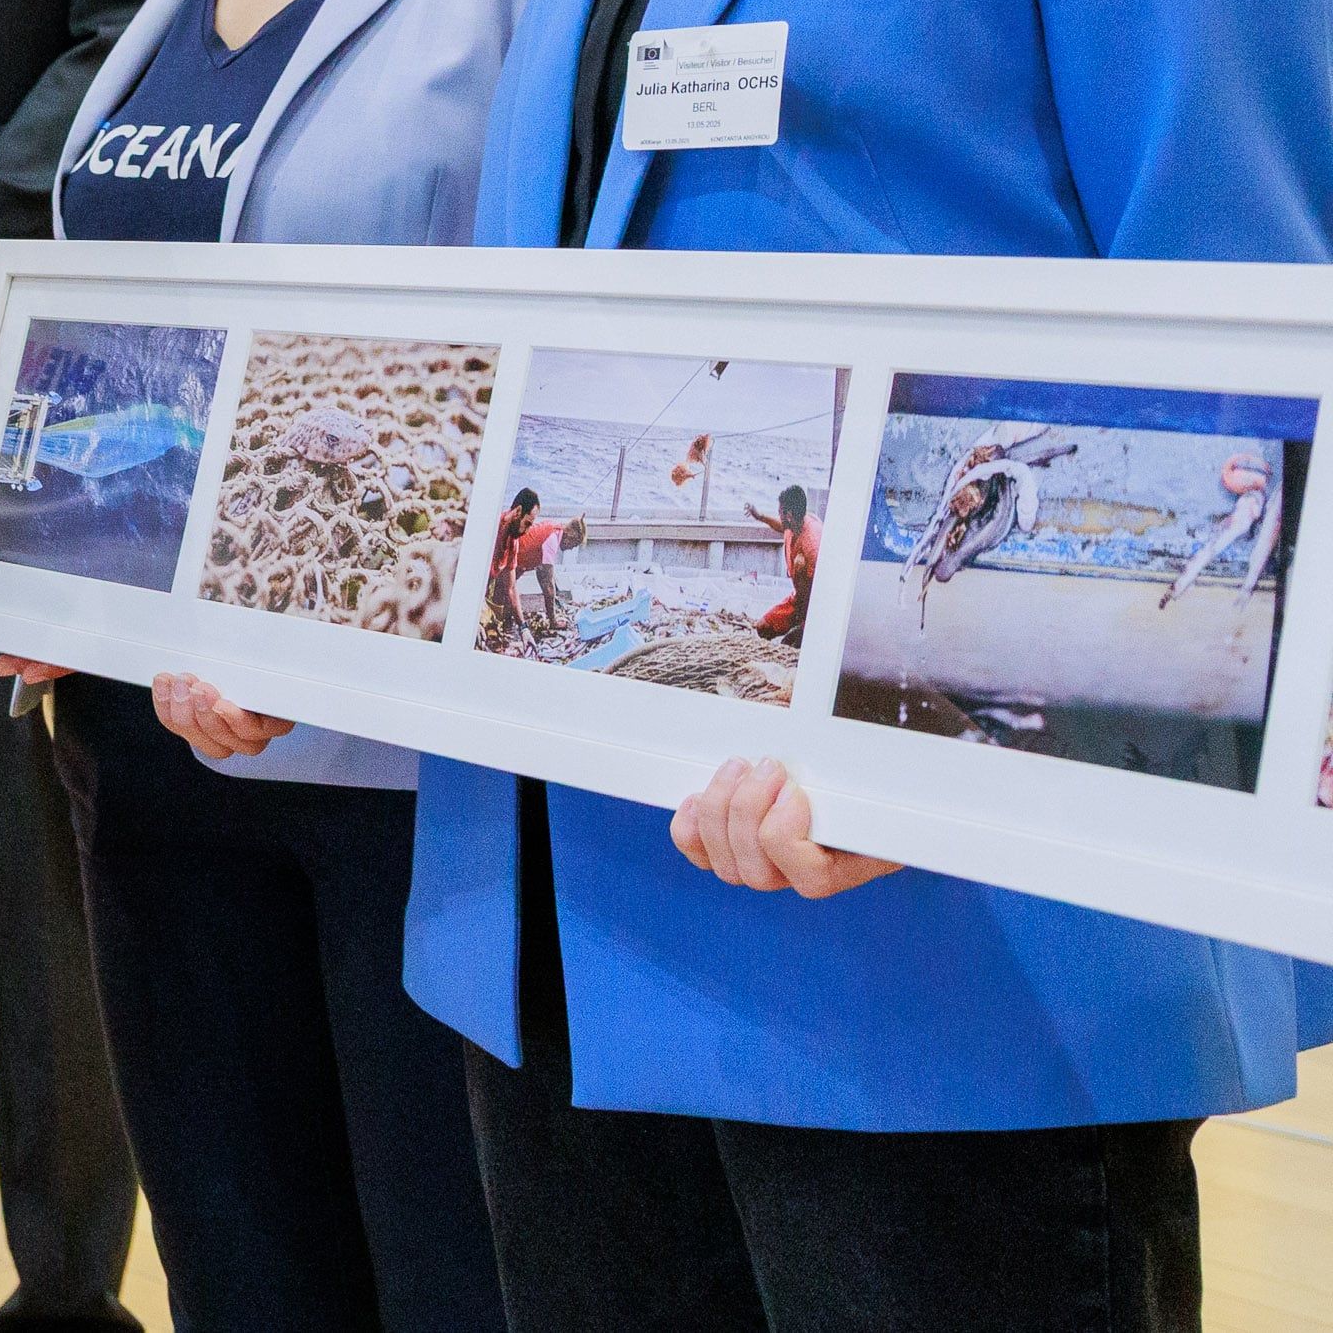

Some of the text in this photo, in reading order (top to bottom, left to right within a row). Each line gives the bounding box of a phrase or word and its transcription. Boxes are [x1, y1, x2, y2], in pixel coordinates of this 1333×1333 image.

[737, 56, 774, 66] Besucher
[636, 75, 779, 96] Julia Katharina OCHS
[692, 101, 717, 113] BERL
